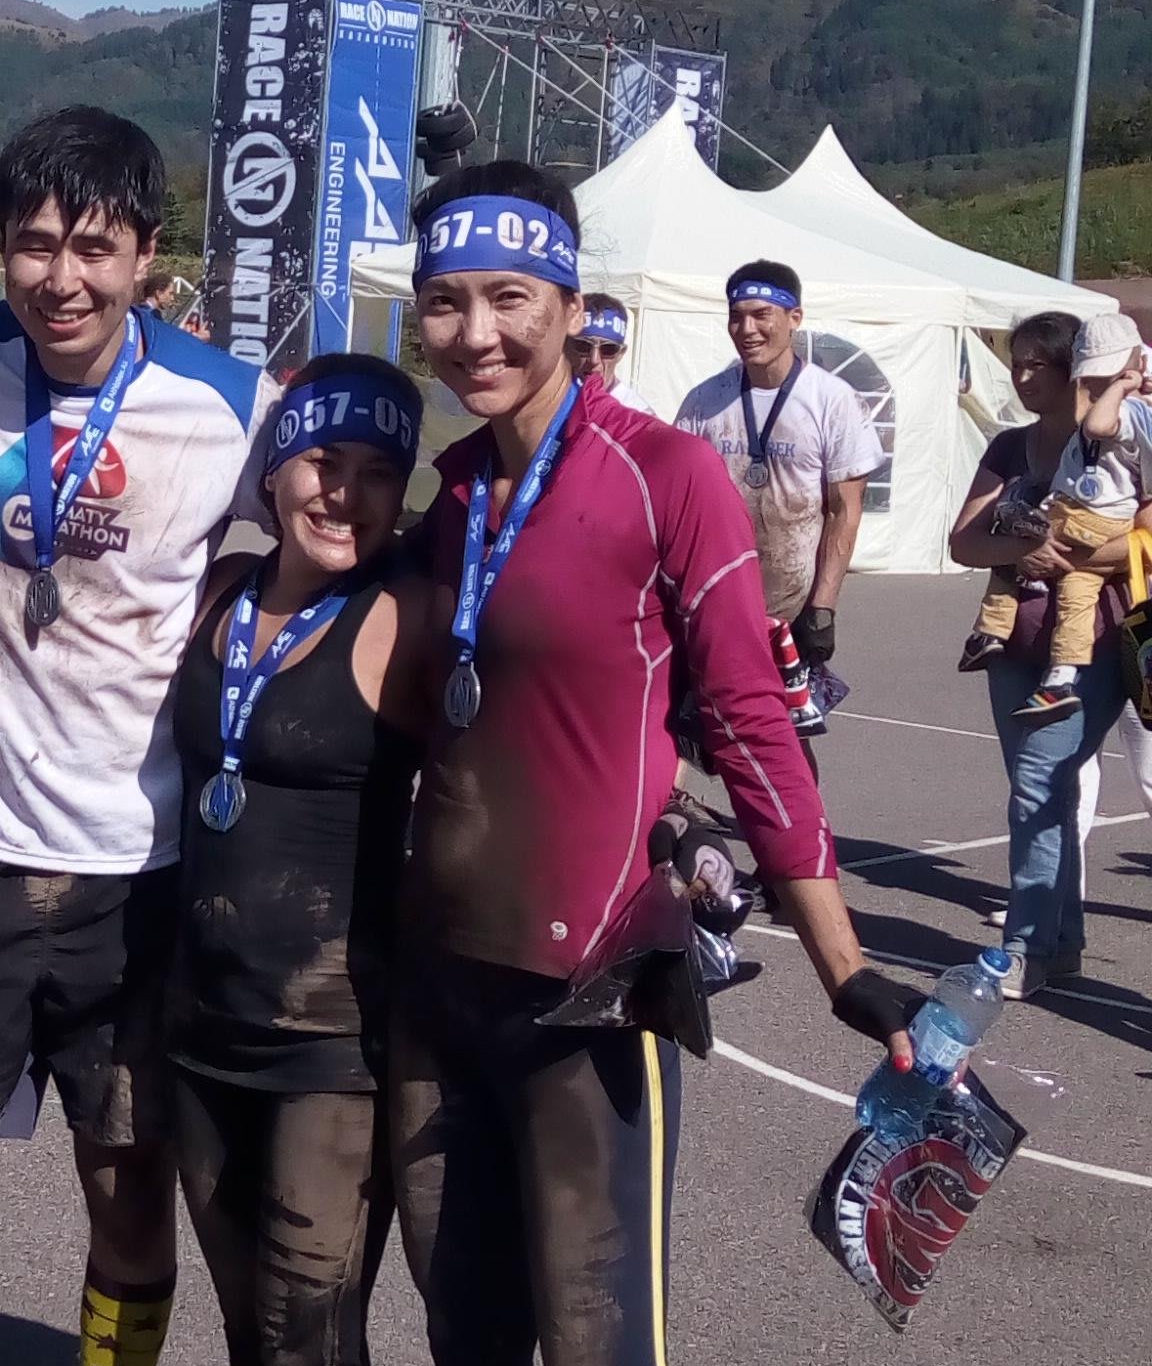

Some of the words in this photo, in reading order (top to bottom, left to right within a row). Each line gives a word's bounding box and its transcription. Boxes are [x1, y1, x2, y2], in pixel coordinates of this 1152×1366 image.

[339, 1, 367, 21] RACE
[387, 8, 419, 30] NATION
[242, 3, 289, 122] RACE
[321, 141, 346, 296] ENGINEERING
[429, 210, 549, 260] 57-02
[229, 237, 274, 366] NATIO
[303, 391, 412, 451] 57-05
[14, 509, 125, 547] MATHON
